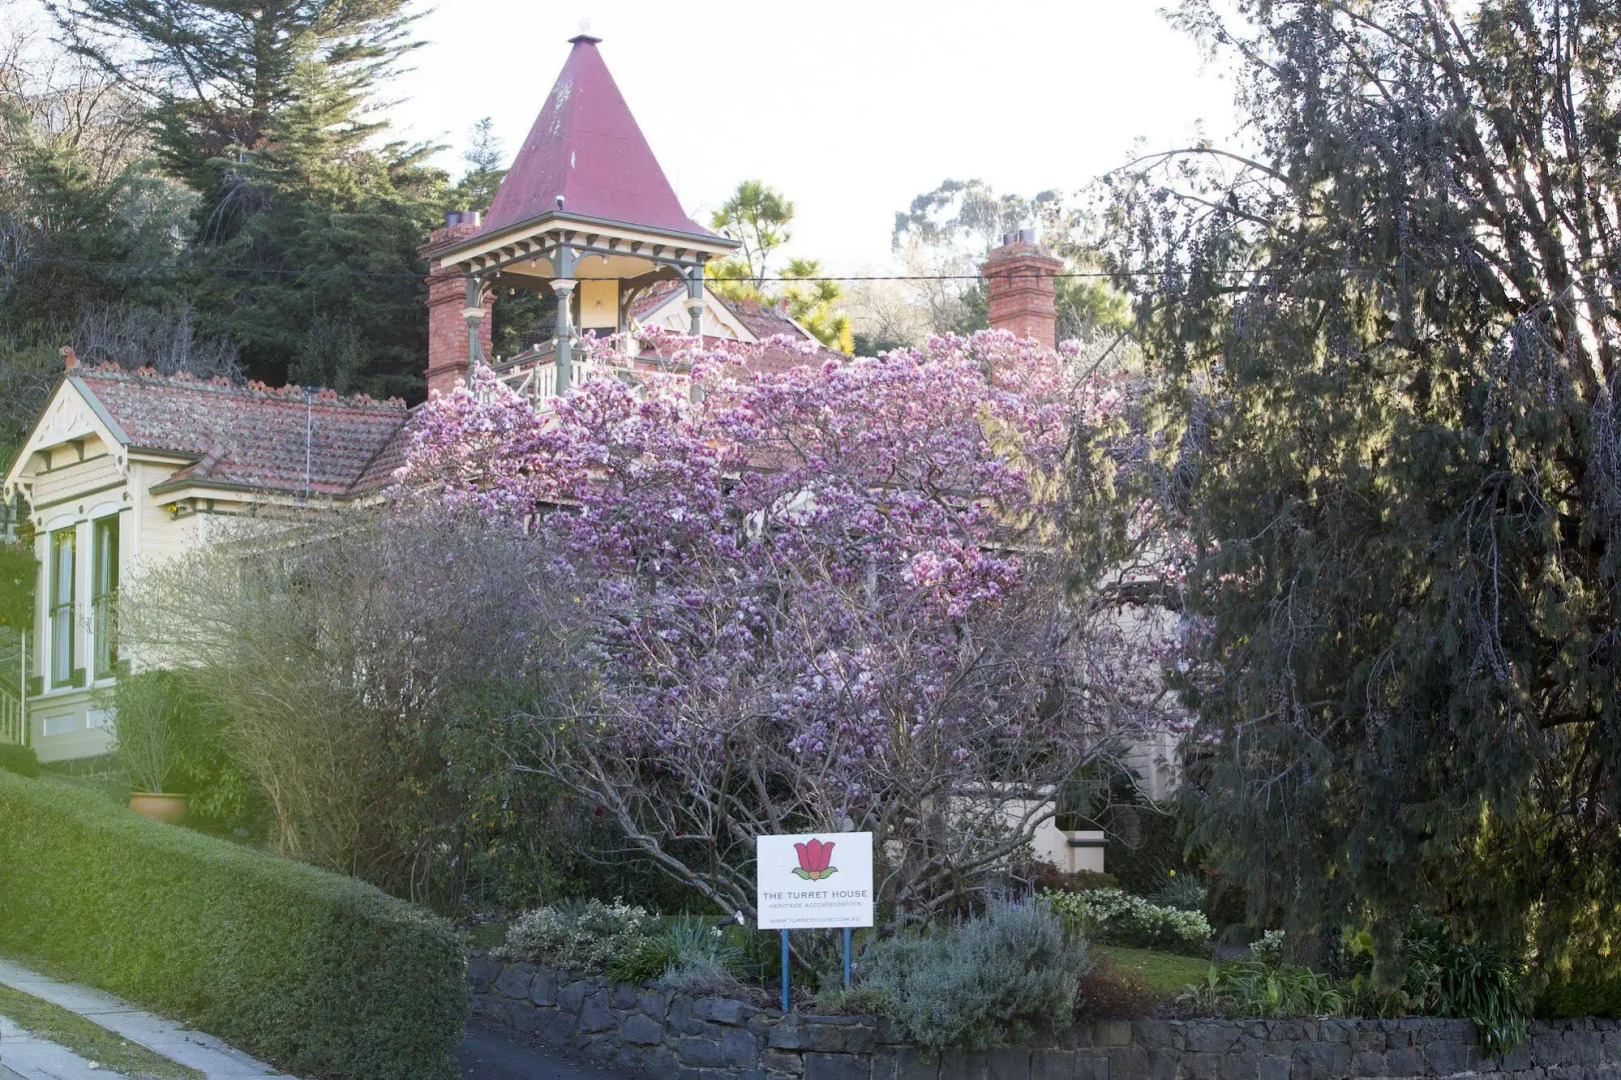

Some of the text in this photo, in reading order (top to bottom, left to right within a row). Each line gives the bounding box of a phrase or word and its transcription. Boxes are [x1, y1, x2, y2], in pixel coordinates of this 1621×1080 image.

[763, 890, 868, 900] THE TURRET HOUSE
